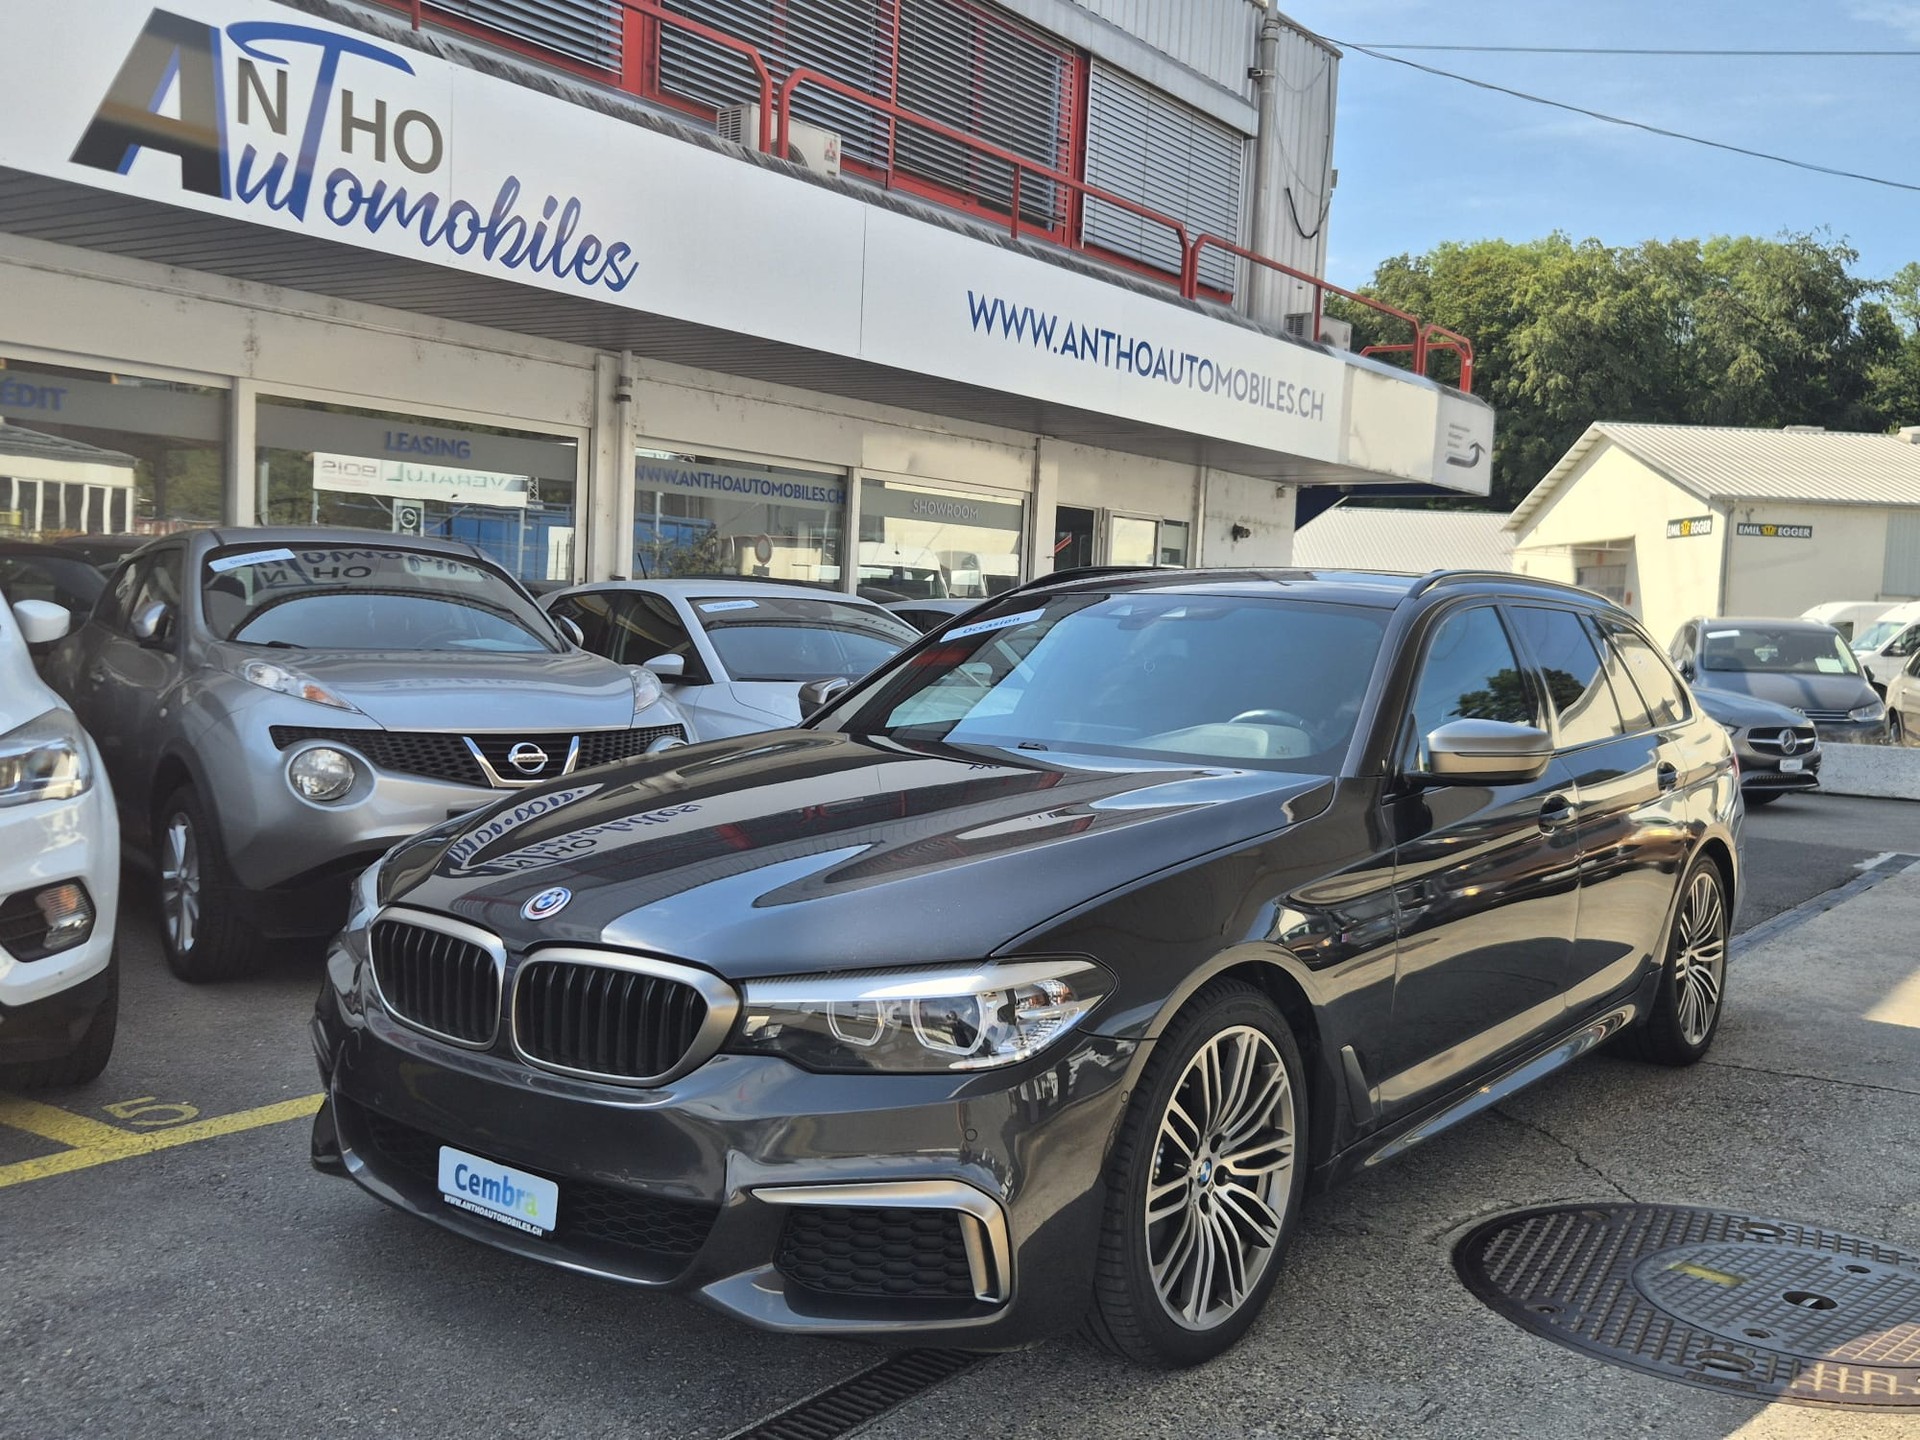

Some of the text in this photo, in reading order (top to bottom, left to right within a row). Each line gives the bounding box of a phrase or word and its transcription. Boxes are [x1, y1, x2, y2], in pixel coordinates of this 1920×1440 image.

[967, 290, 1324, 422] WWW.ANTHOAUTOMOBILES.CH
[384, 430, 472, 460] LEASING
[913, 498, 979, 520] SHOWROOM
[1667, 520, 1711, 537] EMIL EGGER
[1738, 526, 1811, 538] EMIL EGGER
[962, 616, 1021, 634] Occasion
[101, 1096, 200, 1126] 5
[454, 1163, 538, 1217] Cembra
[443, 1193, 543, 1237] WWW.ANTHOAUTOMOBILES.CH
